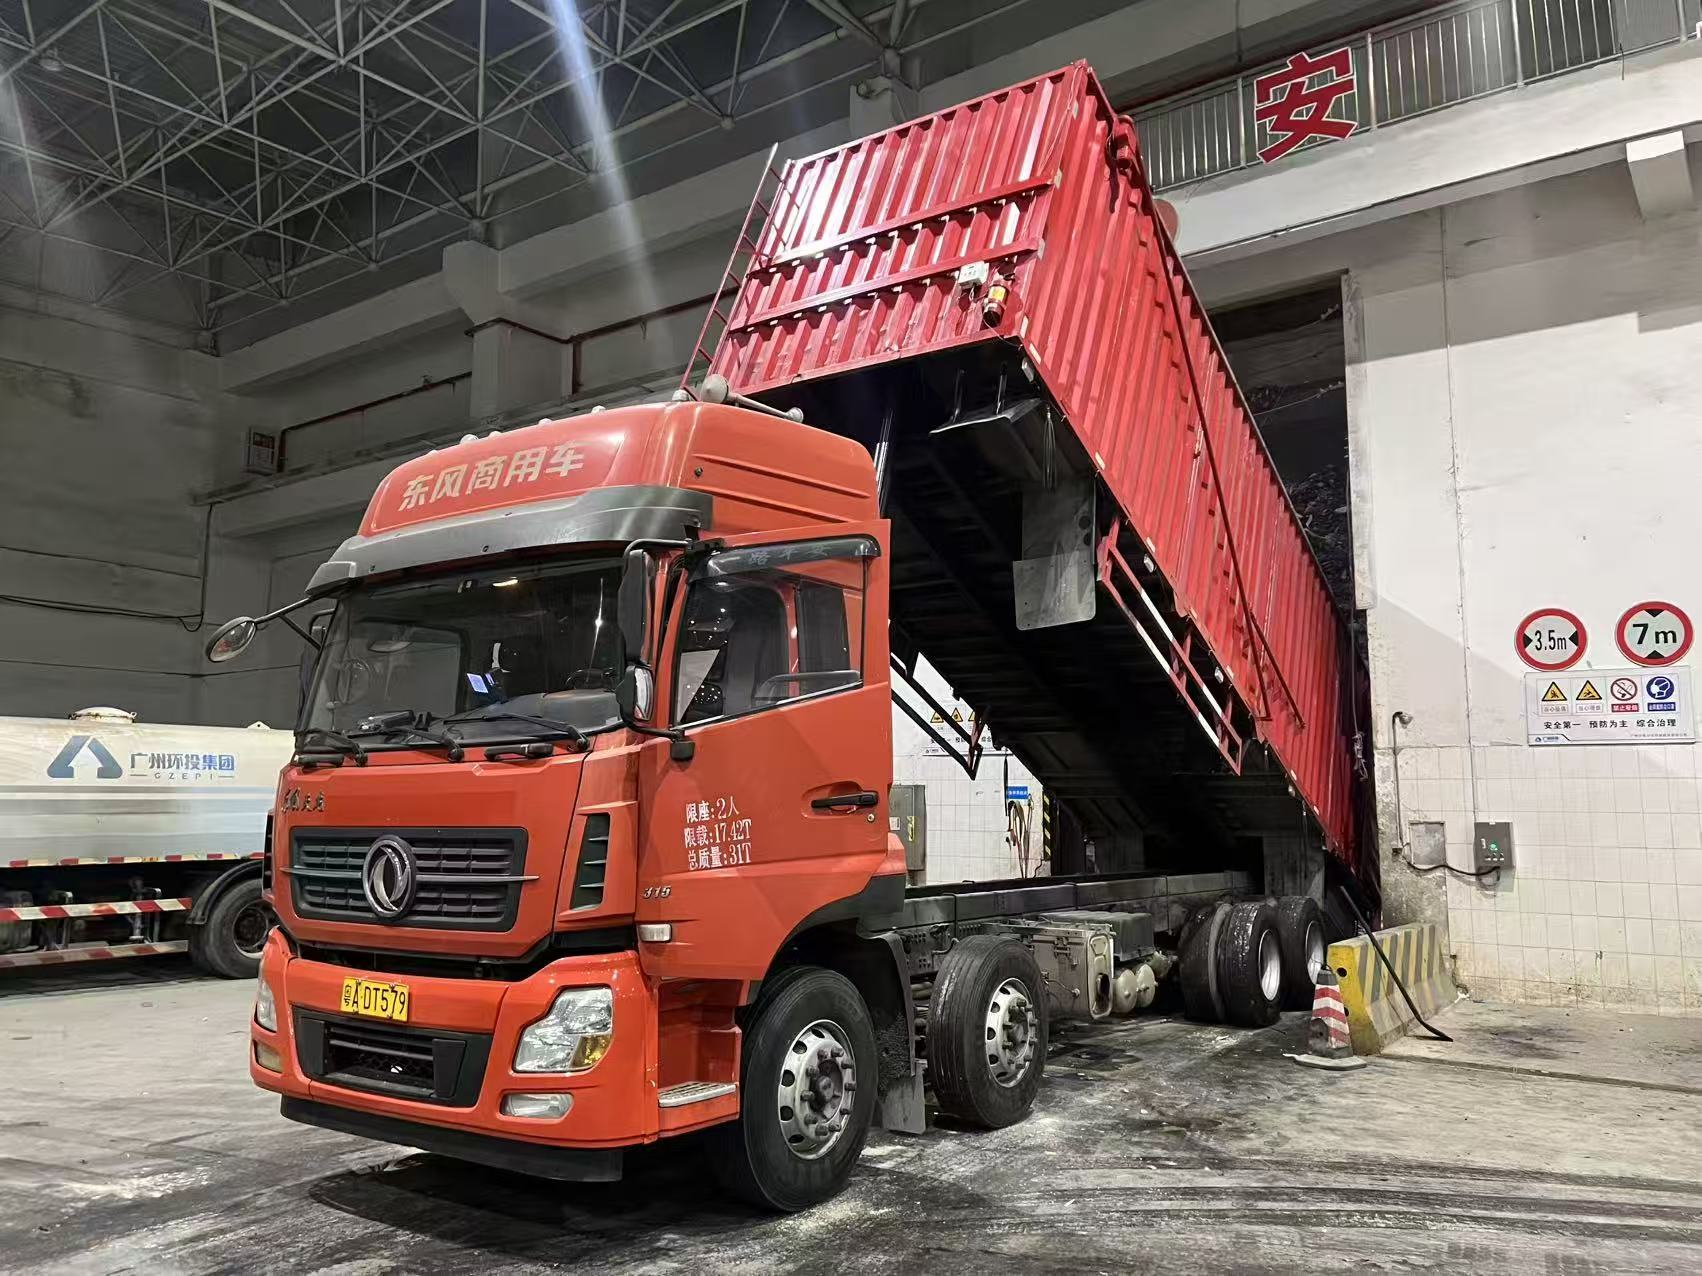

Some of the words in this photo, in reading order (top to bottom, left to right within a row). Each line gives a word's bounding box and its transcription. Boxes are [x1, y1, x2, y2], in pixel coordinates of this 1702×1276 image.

[1254, 46, 1358, 164] 安
[399, 440, 584, 512] 东风商用车
[1534, 629, 1567, 651] 3.5m
[1632, 623, 1677, 645] 7m
[1543, 721, 1581, 730] 安全第一
[1589, 720, 1628, 729] 预防为主
[1636, 718, 1677, 727] 综合治理
[130, 753, 234, 771] 广州环投集团
[154, 772, 213, 780] GZEPI
